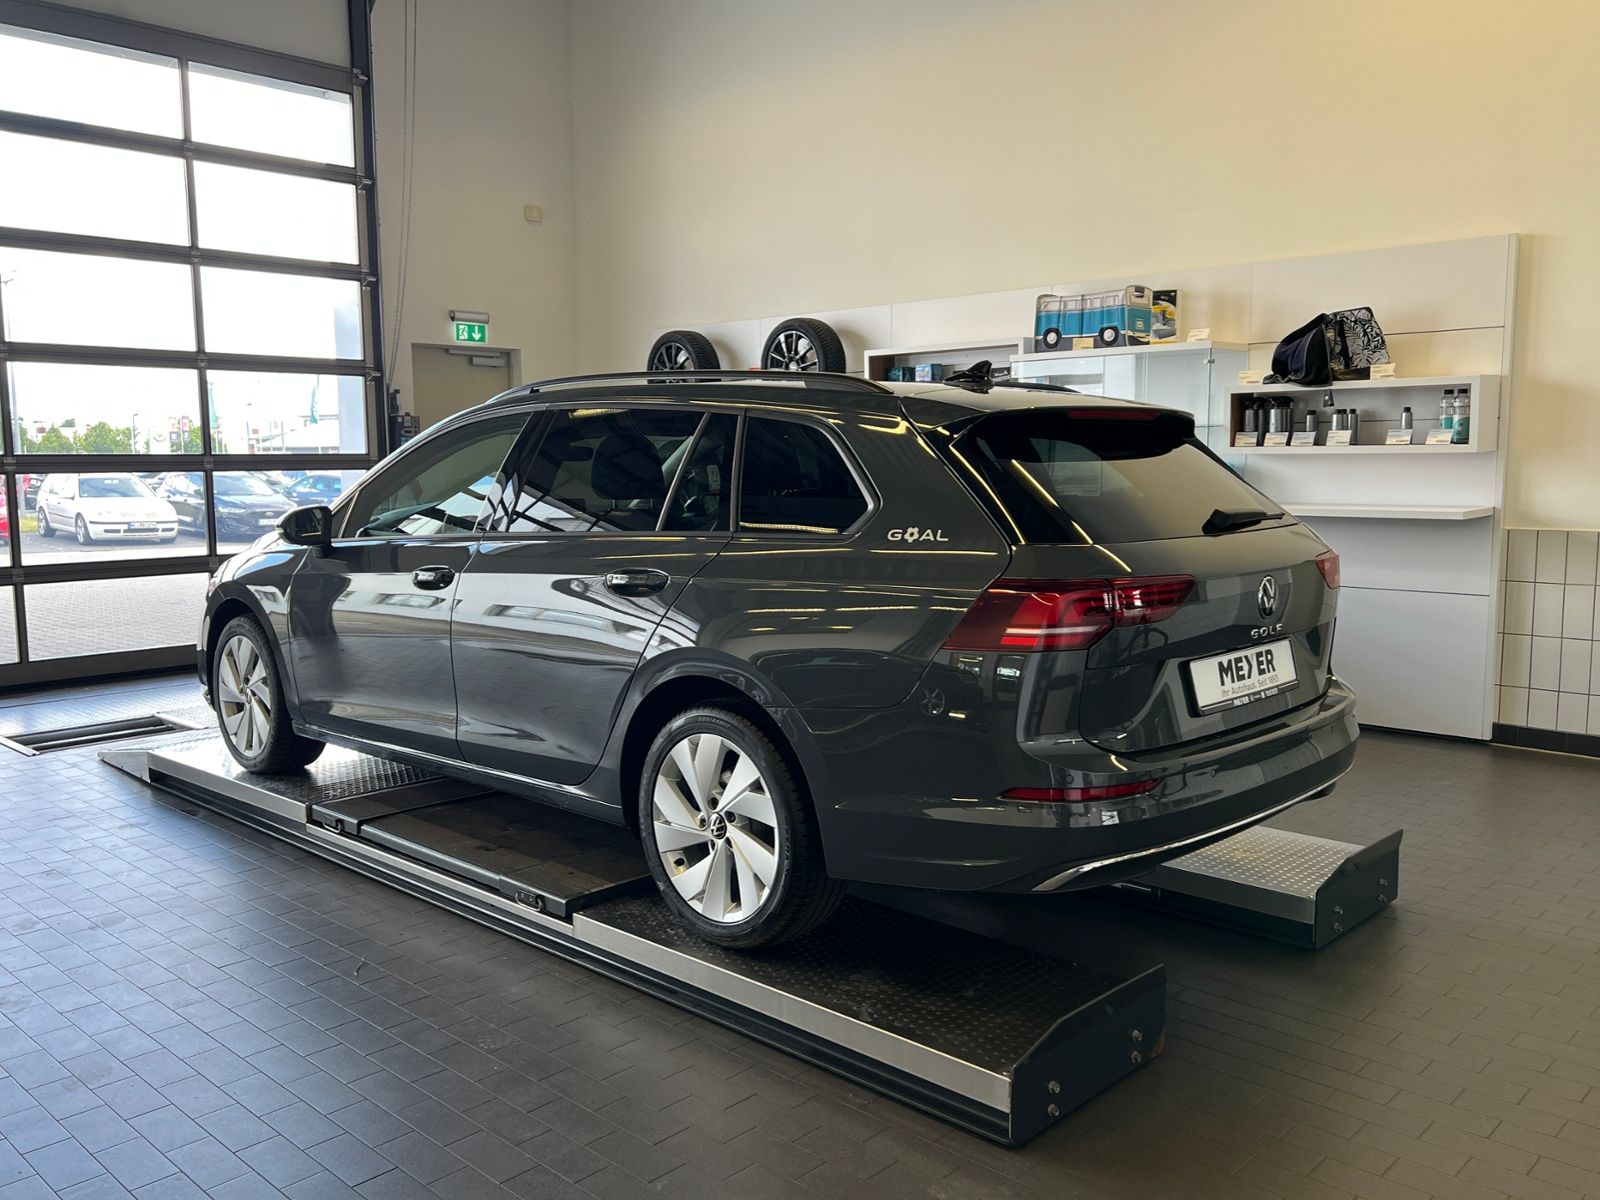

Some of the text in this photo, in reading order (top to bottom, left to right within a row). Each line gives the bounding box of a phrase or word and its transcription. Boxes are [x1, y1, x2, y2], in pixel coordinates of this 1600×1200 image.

[887, 526, 949, 543] GOAL
[1250, 623, 1283, 639] GOLF
[1218, 649, 1276, 686] MEYER
